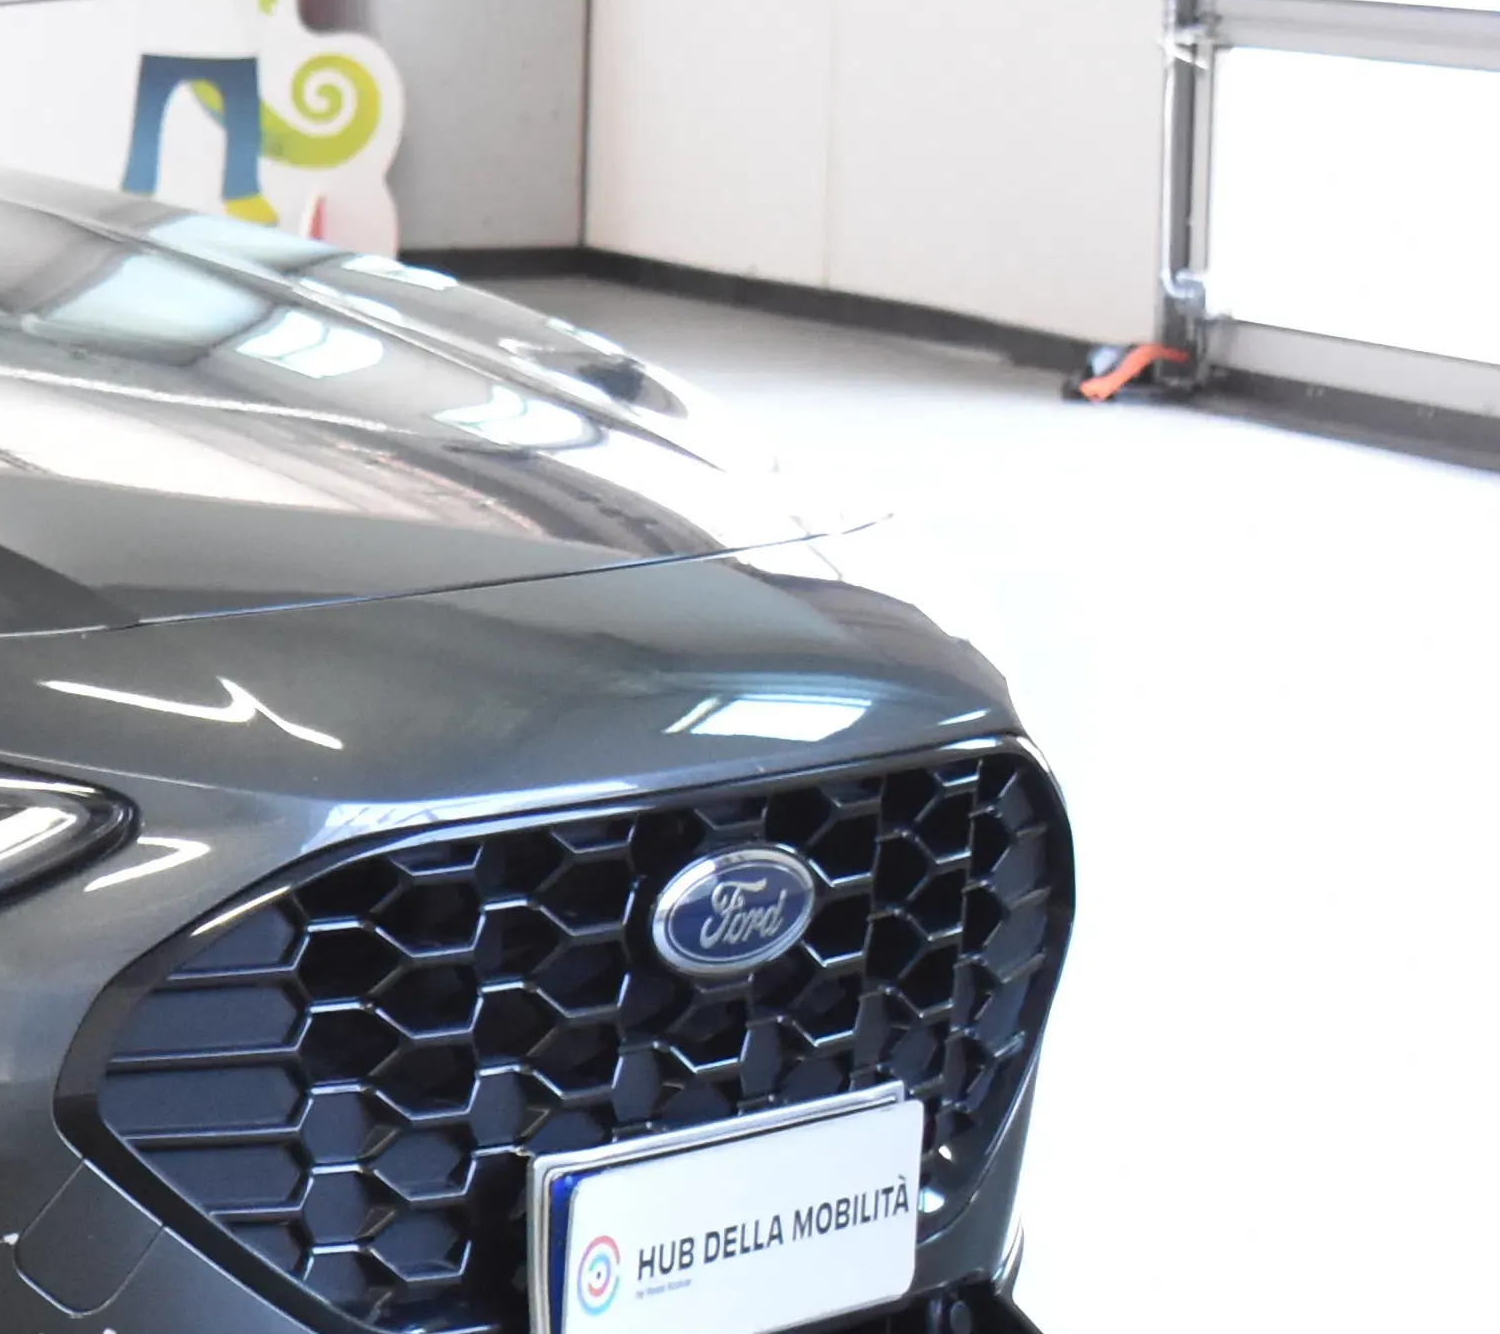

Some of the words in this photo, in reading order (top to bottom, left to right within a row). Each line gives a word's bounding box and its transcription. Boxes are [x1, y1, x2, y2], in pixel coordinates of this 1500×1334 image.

[700, 878, 787, 949] Ford
[637, 1236, 695, 1281] HUB
[703, 1214, 784, 1264] DELLA
[792, 1174, 910, 1241] MOBILITÀ
